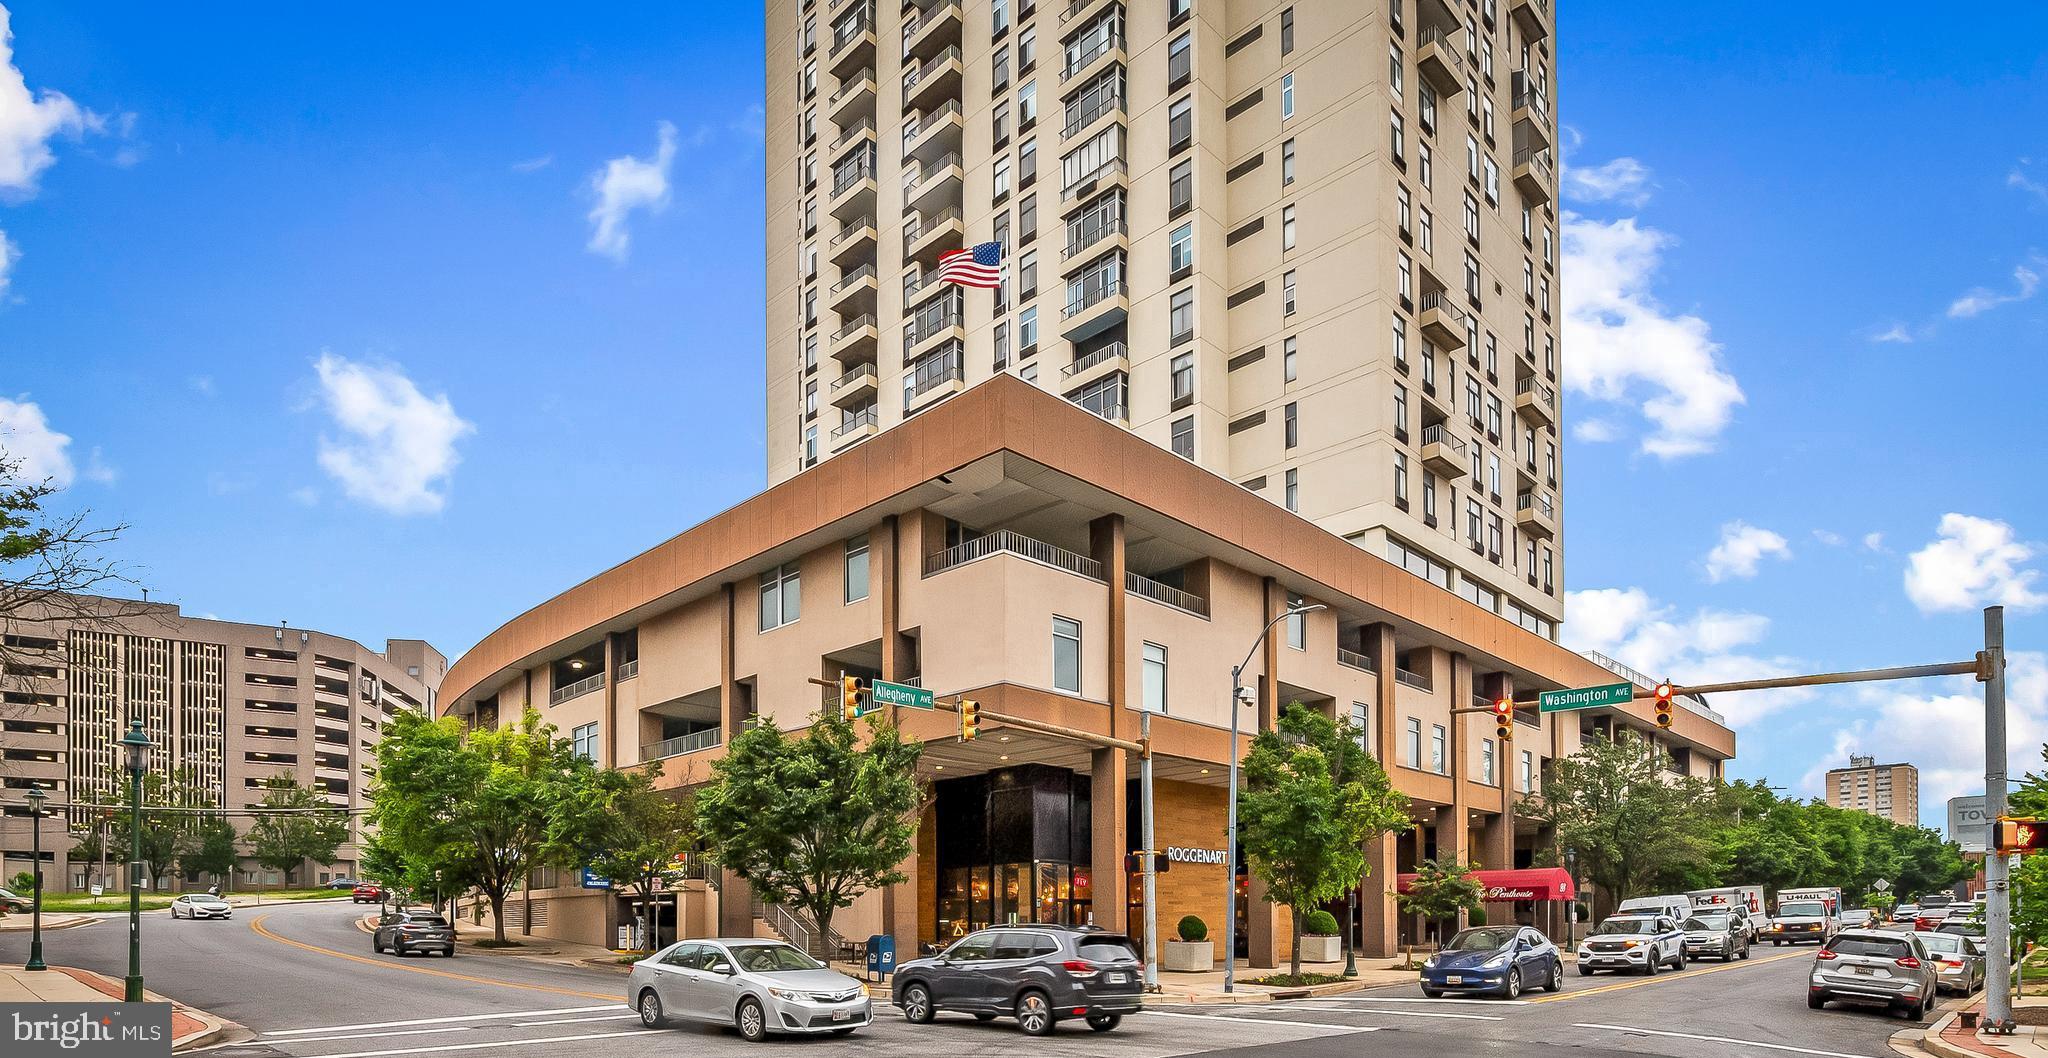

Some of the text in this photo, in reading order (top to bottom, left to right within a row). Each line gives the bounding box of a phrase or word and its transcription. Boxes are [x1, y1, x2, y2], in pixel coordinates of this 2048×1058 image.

[876, 685, 931, 705] Allegheny AVE
[1545, 687, 1629, 706] Washington AVE
[1168, 846, 1227, 865] ROGGENART
[1489, 886, 1534, 899] Penthouse
[1695, 895, 1727, 906] FedEx
